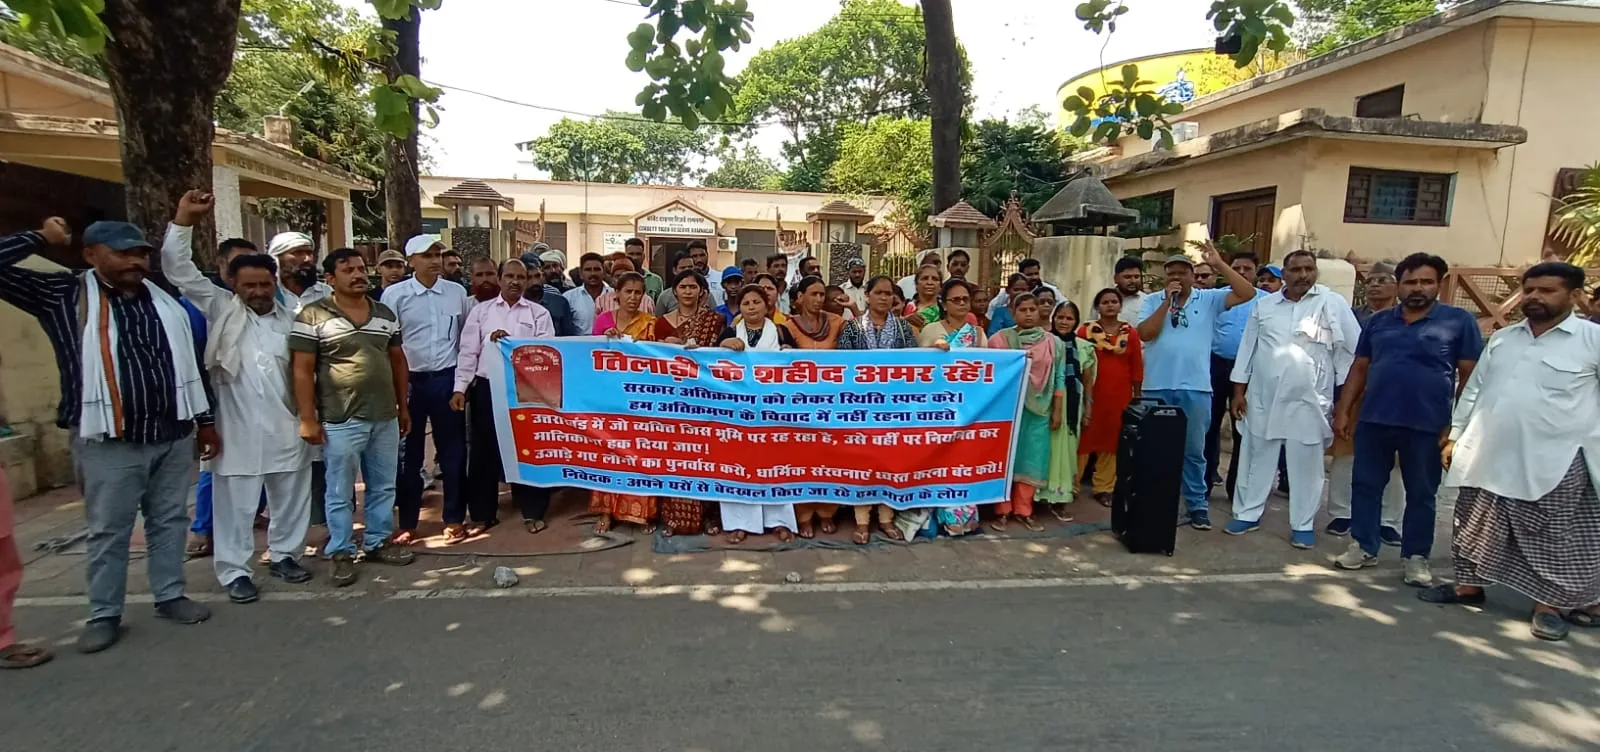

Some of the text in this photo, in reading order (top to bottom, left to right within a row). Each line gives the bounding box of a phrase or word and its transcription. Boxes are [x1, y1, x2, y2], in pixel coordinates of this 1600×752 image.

[592, 350, 995, 384] तिलाड़ी के शहीद अमर रहें!
[623, 382, 676, 395] सरकार
[680, 386, 757, 404] अतिक्रमण
[762, 392, 786, 404] को
[791, 392, 835, 404] लेकर
[840, 392, 886, 404] स्थिति
[891, 394, 928, 404] स्पष्ट
[629, 400, 956, 422] हम अतिक्रमण के विवाद में नहीं रहना चाहते
[592, 417, 606, 431] में
[608, 418, 629, 431] जो
[680, 424, 712, 436] जिस
[715, 426, 743, 442] भूमि
[748, 432, 766, 444] पर
[771, 432, 788, 442] रह
[794, 432, 816, 442] रहा
[844, 432, 867, 445] उसे
[872, 432, 900, 446] वहीं
[902, 434, 922, 445] पर
[980, 428, 1000, 438] कर
[606, 438, 632, 450] हक
[636, 437, 668, 450] दिया
[534, 446, 573, 462] उजाड़े
[577, 452, 598, 462] गए
[641, 458, 661, 468] का
[666, 458, 716, 472] पुनर्वास
[756, 464, 806, 478] धार्मिक
[810, 464, 872, 480] संरचनाएं
[914, 467, 948, 478] करना
[952, 464, 973, 478] बंद
[562, 468, 612, 485] निवेदक
[627, 478, 664, 490] अपने
[668, 480, 694, 492] घरों
[696, 480, 709, 493] से
[714, 482, 767, 498] बेदखल
[771, 486, 803, 498] किए
[808, 486, 828, 496] जा
[832, 486, 850, 498] रहे
[856, 490, 877, 498] हम
[882, 489, 914, 502] भारत
[918, 488, 932, 500] के
[936, 488, 968, 499] लोग
